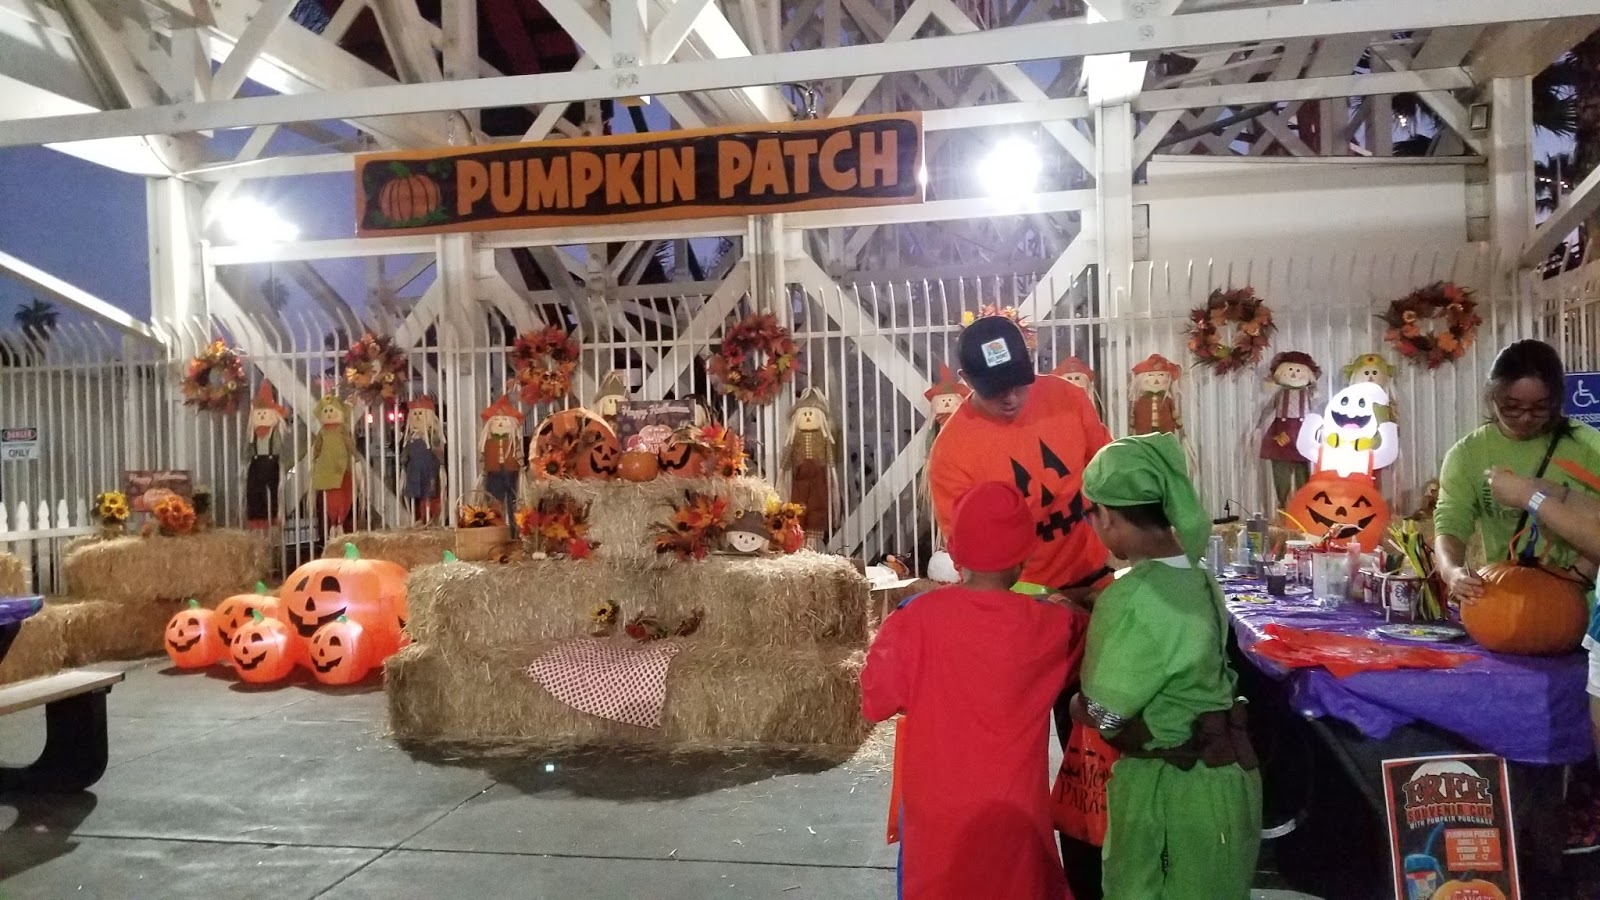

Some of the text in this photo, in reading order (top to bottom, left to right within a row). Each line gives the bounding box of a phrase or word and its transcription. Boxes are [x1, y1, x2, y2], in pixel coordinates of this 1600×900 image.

[455, 130, 898, 216] PUMPKIN PATCH
[9, 449, 30, 457] ONLY
[1403, 772, 1492, 809] FREE
[1407, 804, 1493, 822] SOUVENIR CUP
[1409, 816, 1493, 829] WITH PUMPKIN PURCHASE
